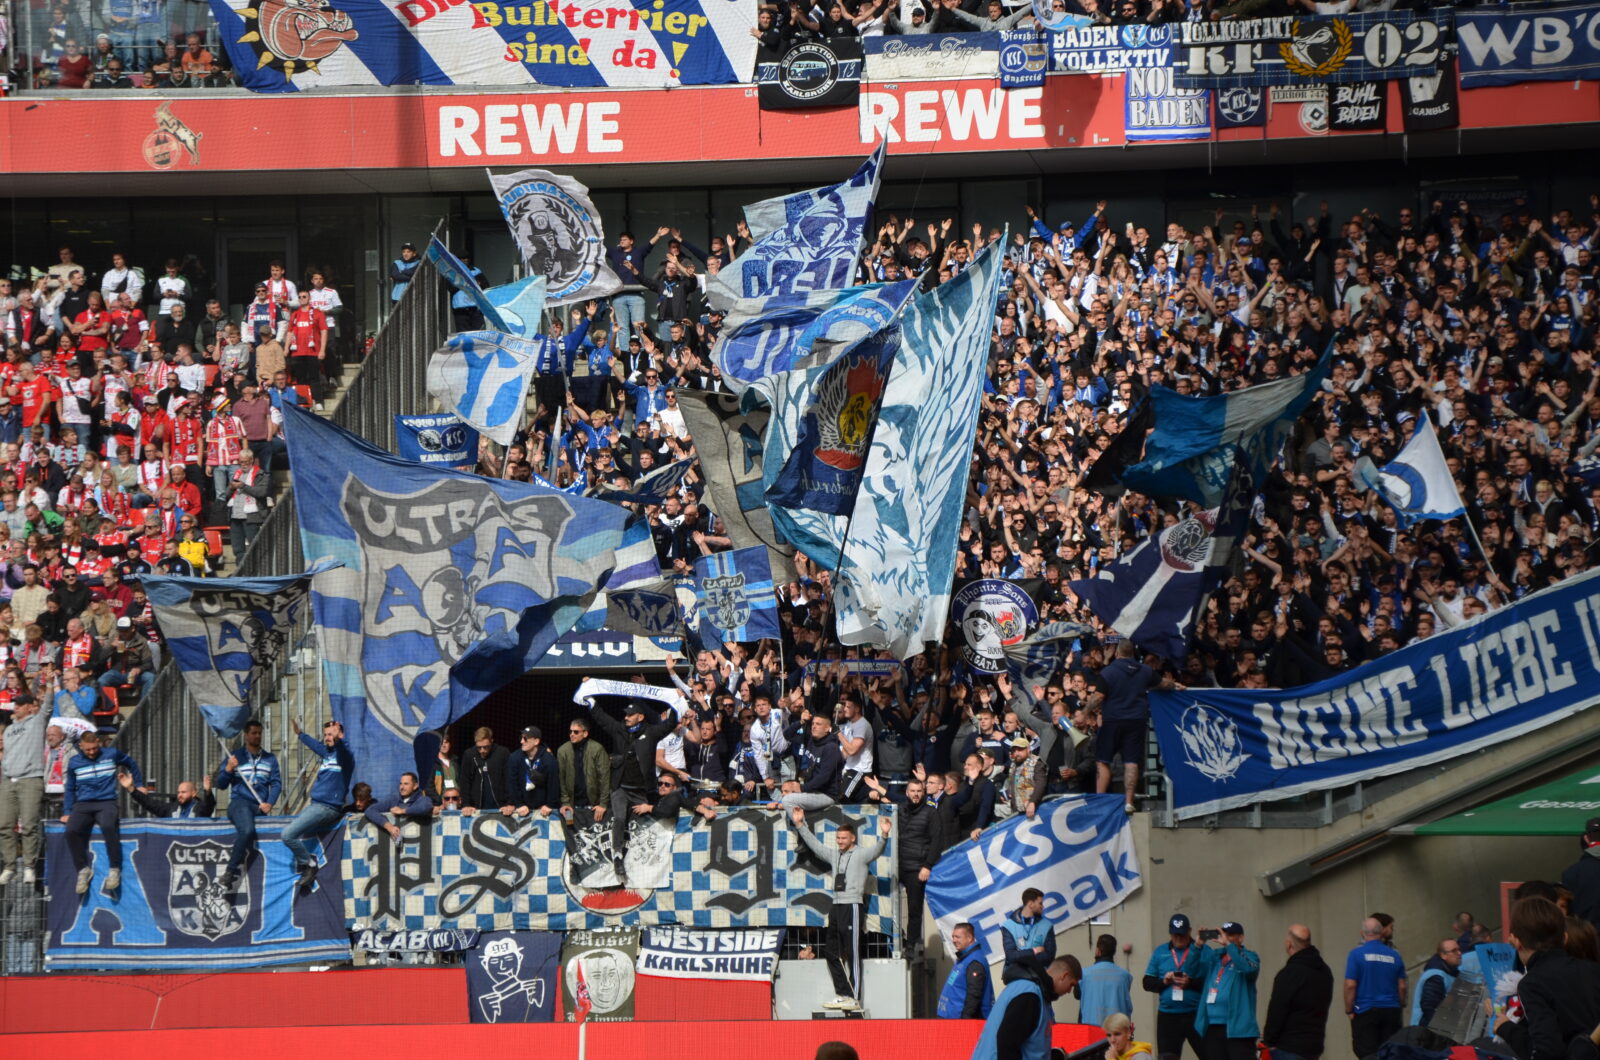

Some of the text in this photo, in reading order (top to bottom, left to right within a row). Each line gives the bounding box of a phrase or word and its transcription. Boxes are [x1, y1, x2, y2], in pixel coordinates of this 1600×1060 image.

[471, 0, 707, 39] Bullterrier
[504, 33, 591, 66] sind
[612, 39, 657, 70] da
[882, 38, 934, 60] Blood
[1006, 49, 1023, 66] KSC
[1054, 48, 1170, 71] KOLLEKTIV
[860, 88, 1046, 143] REWE
[1130, 98, 1207, 128] BADEN
[1232, 94, 1248, 110] KSC
[439, 101, 624, 157] REWE
[446, 431, 462, 446] KSC
[360, 491, 544, 545] ULTRAS
[201, 585, 304, 614] ULTRAS
[1252, 665, 1428, 770] MEINE
[1430, 609, 1577, 731] LIEBE
[175, 848, 237, 863] ULTRA
[967, 799, 1098, 890] KSC
[967, 850, 1141, 955] Feak
[359, 930, 428, 950] ACAB
[433, 931, 449, 948] KSC
[650, 927, 780, 952] WESTSIDE
[644, 953, 773, 974] KARLSRUHE
